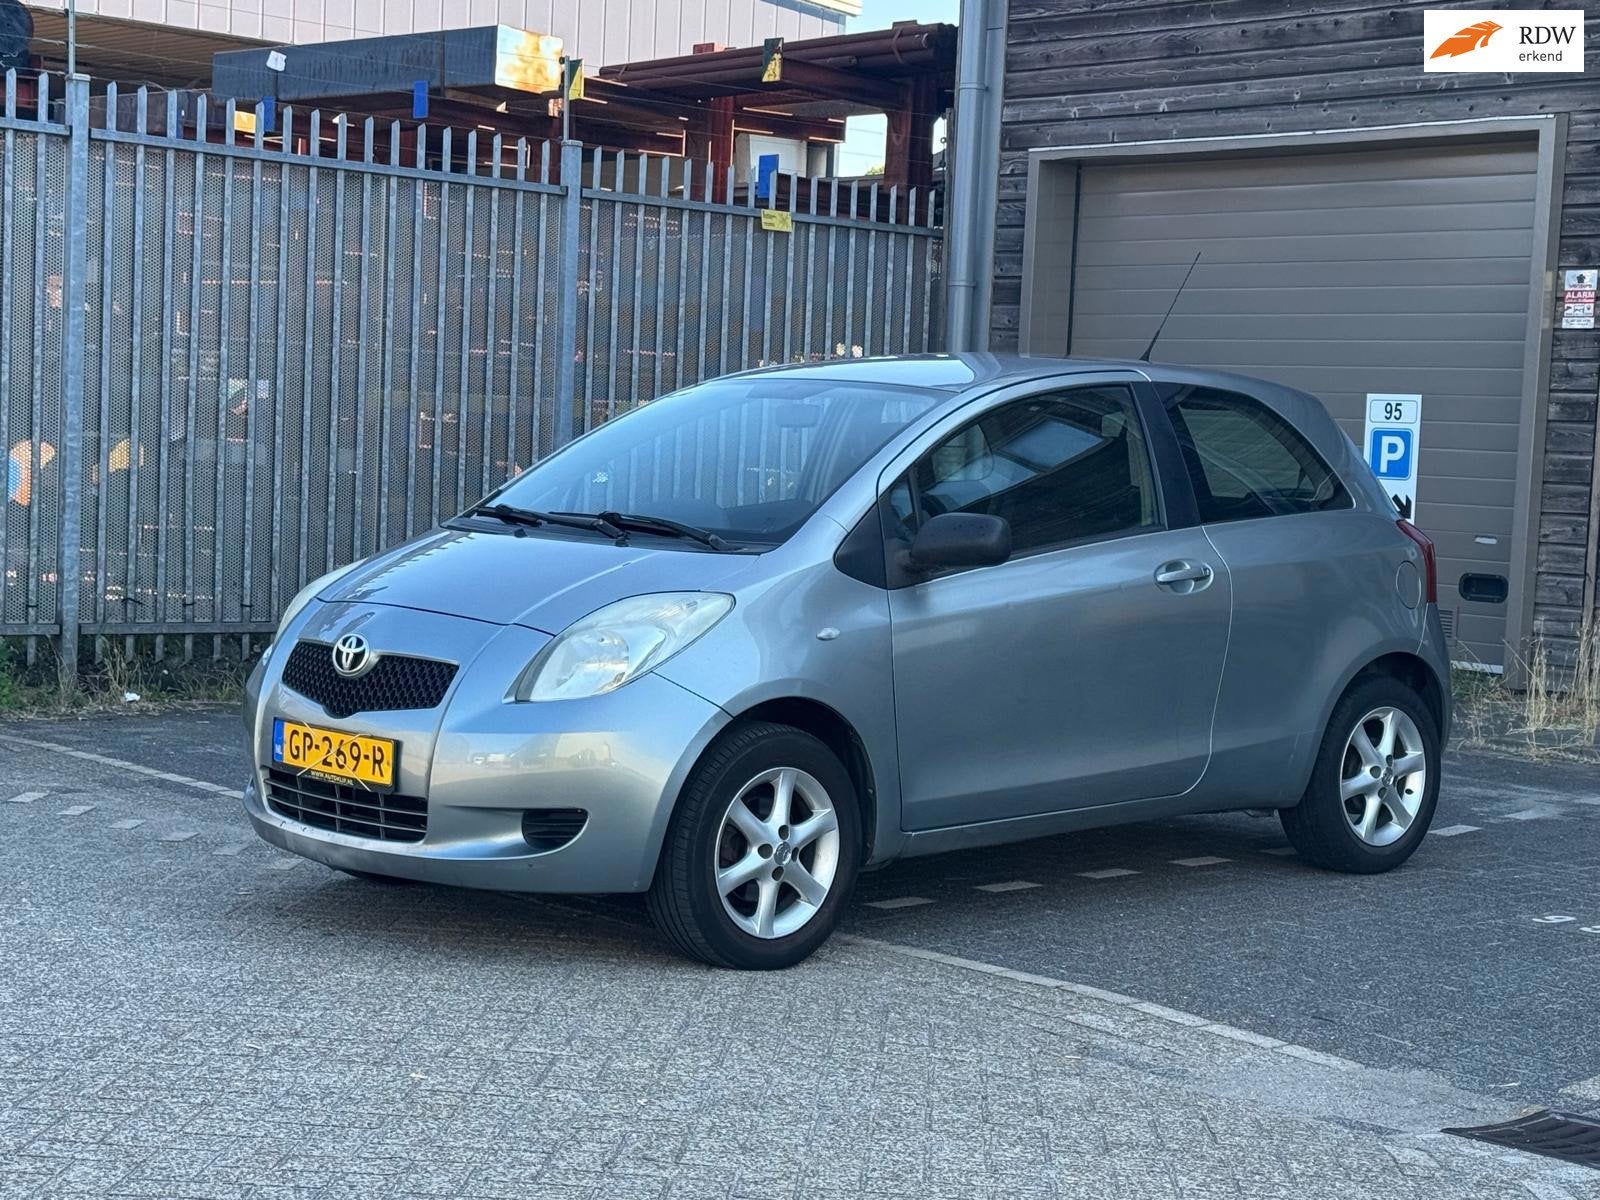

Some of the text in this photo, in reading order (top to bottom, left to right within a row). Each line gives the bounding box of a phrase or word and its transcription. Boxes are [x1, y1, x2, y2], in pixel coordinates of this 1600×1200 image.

[1566, 291, 1595, 299] ALARM
[1384, 402, 1402, 420] 95
[1380, 435, 1405, 473] P
[289, 729, 384, 778] GP-269-R
